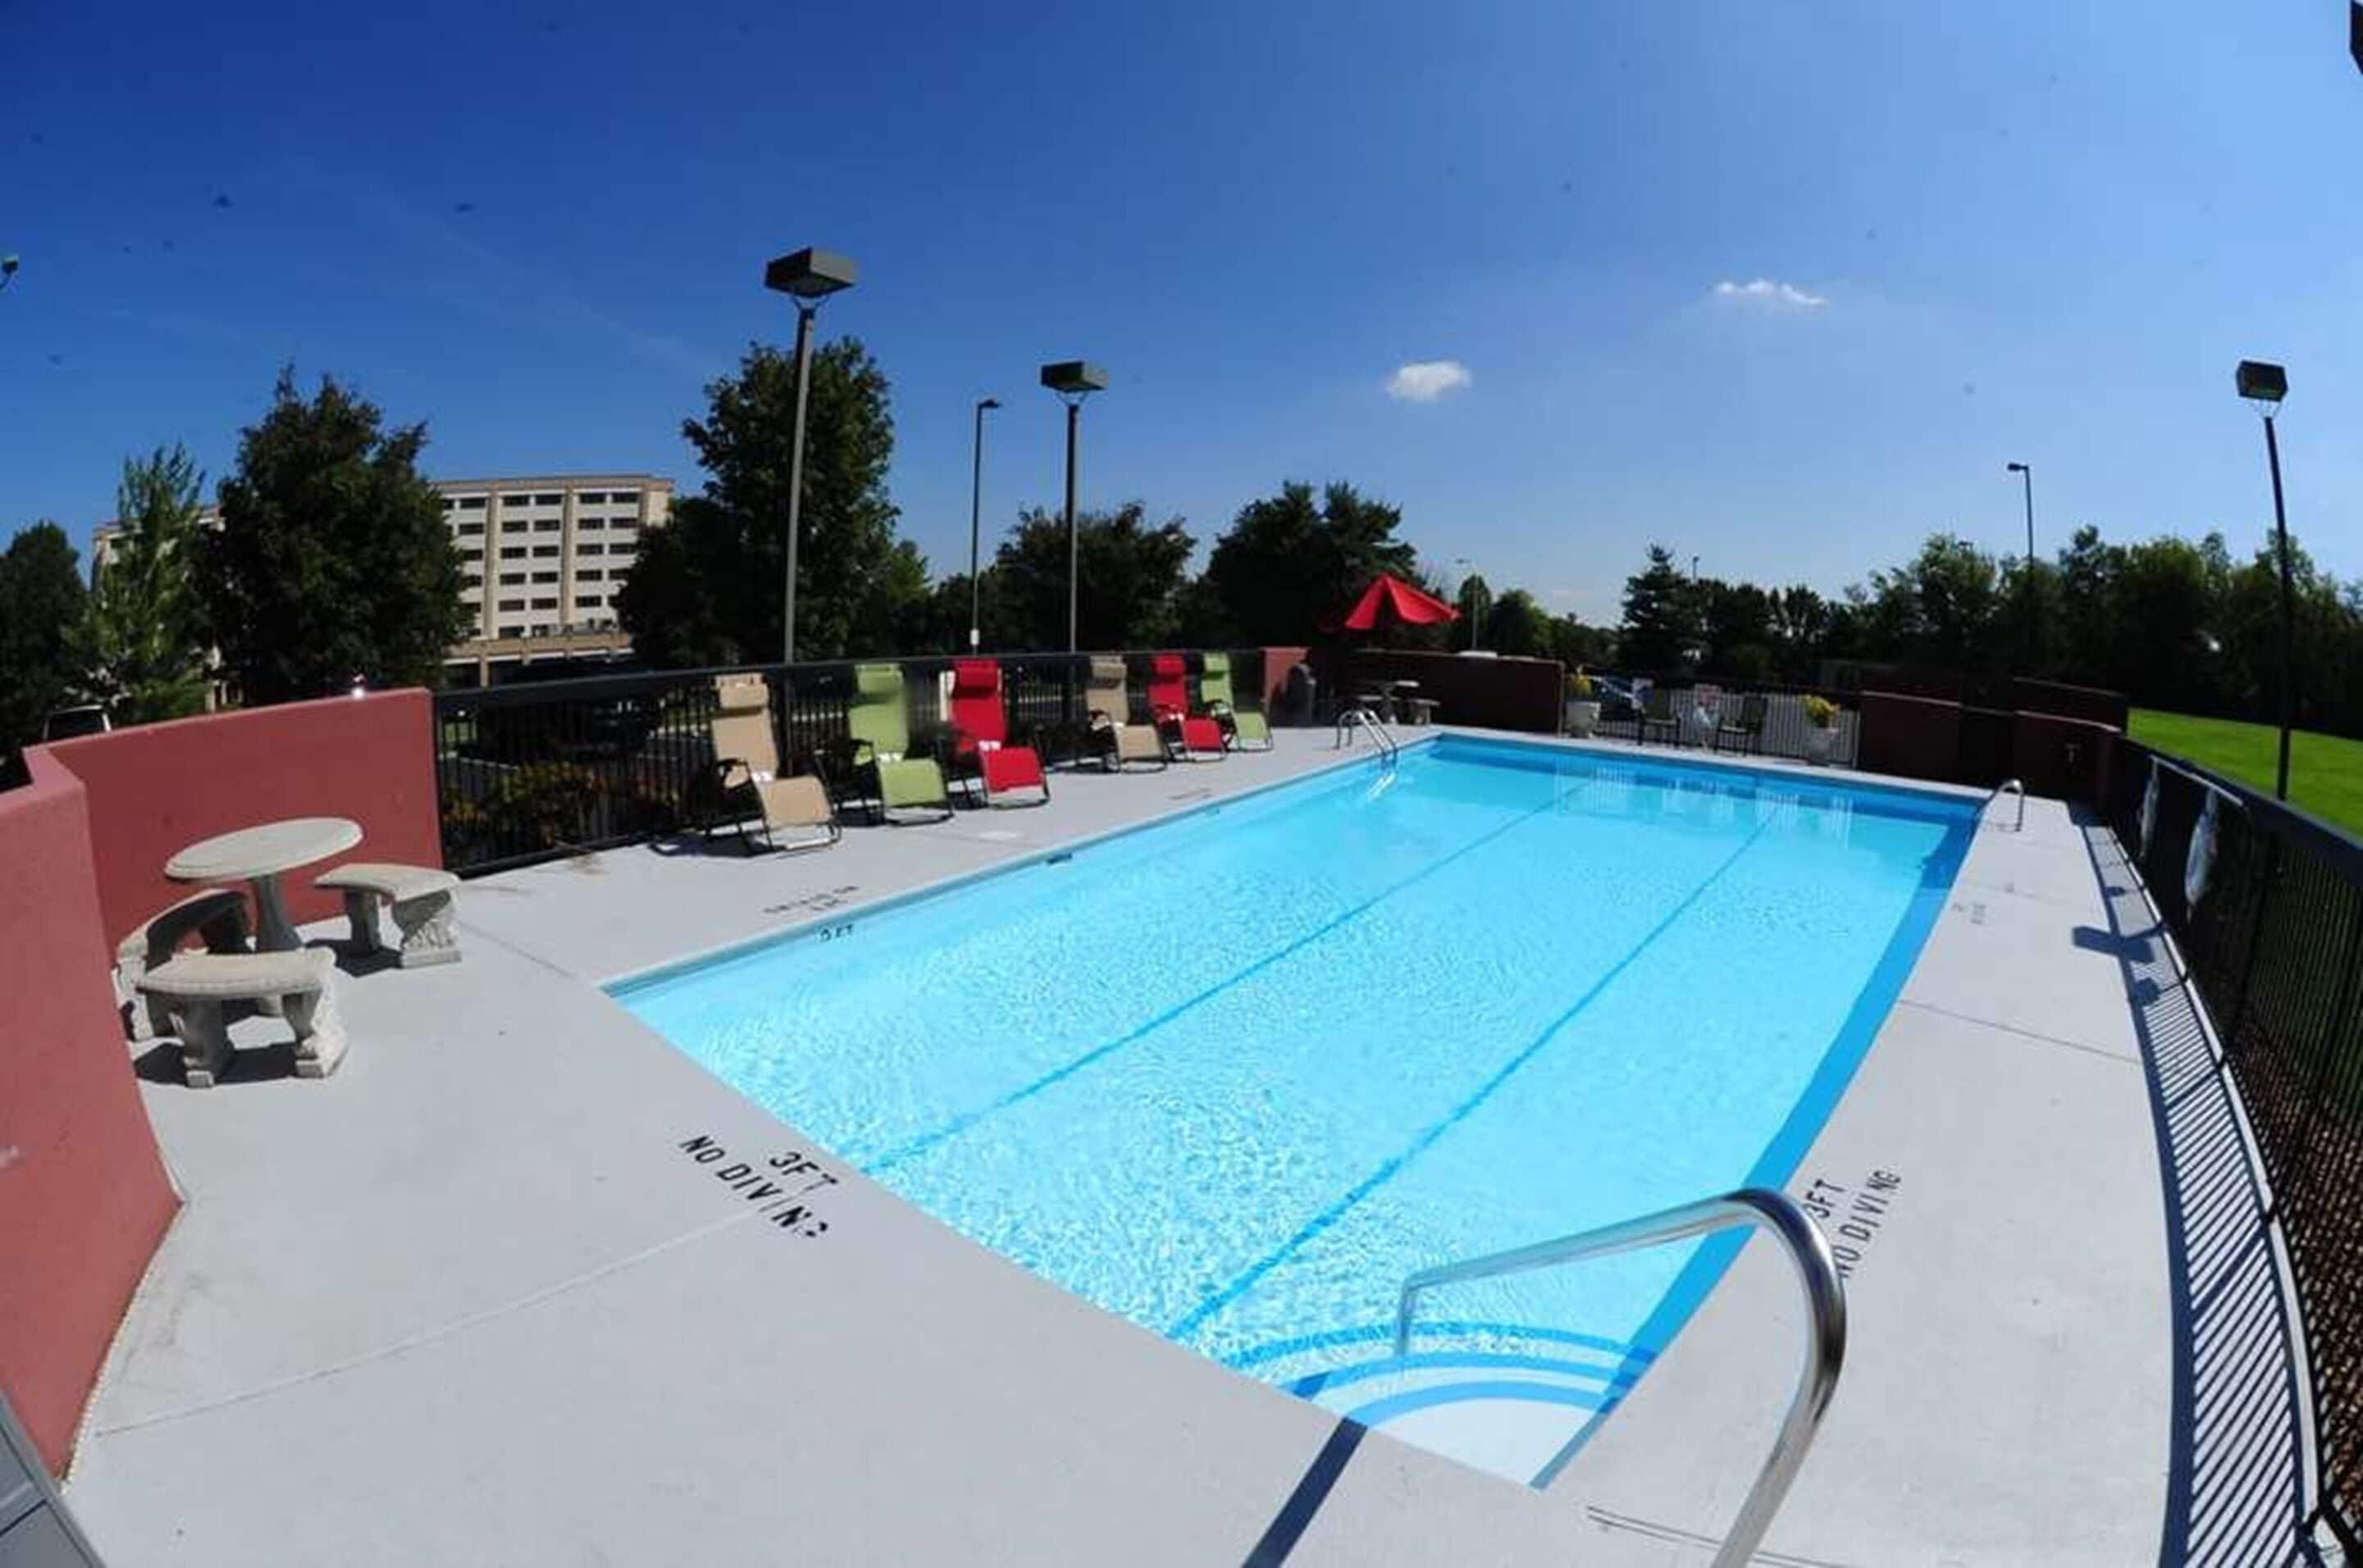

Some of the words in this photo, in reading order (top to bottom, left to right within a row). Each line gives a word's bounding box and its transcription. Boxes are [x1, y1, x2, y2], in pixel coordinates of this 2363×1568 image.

[679, 1135, 725, 1164] NO
[769, 1151, 839, 1191] 3FT
[1804, 1178, 1845, 1219] 3FT
